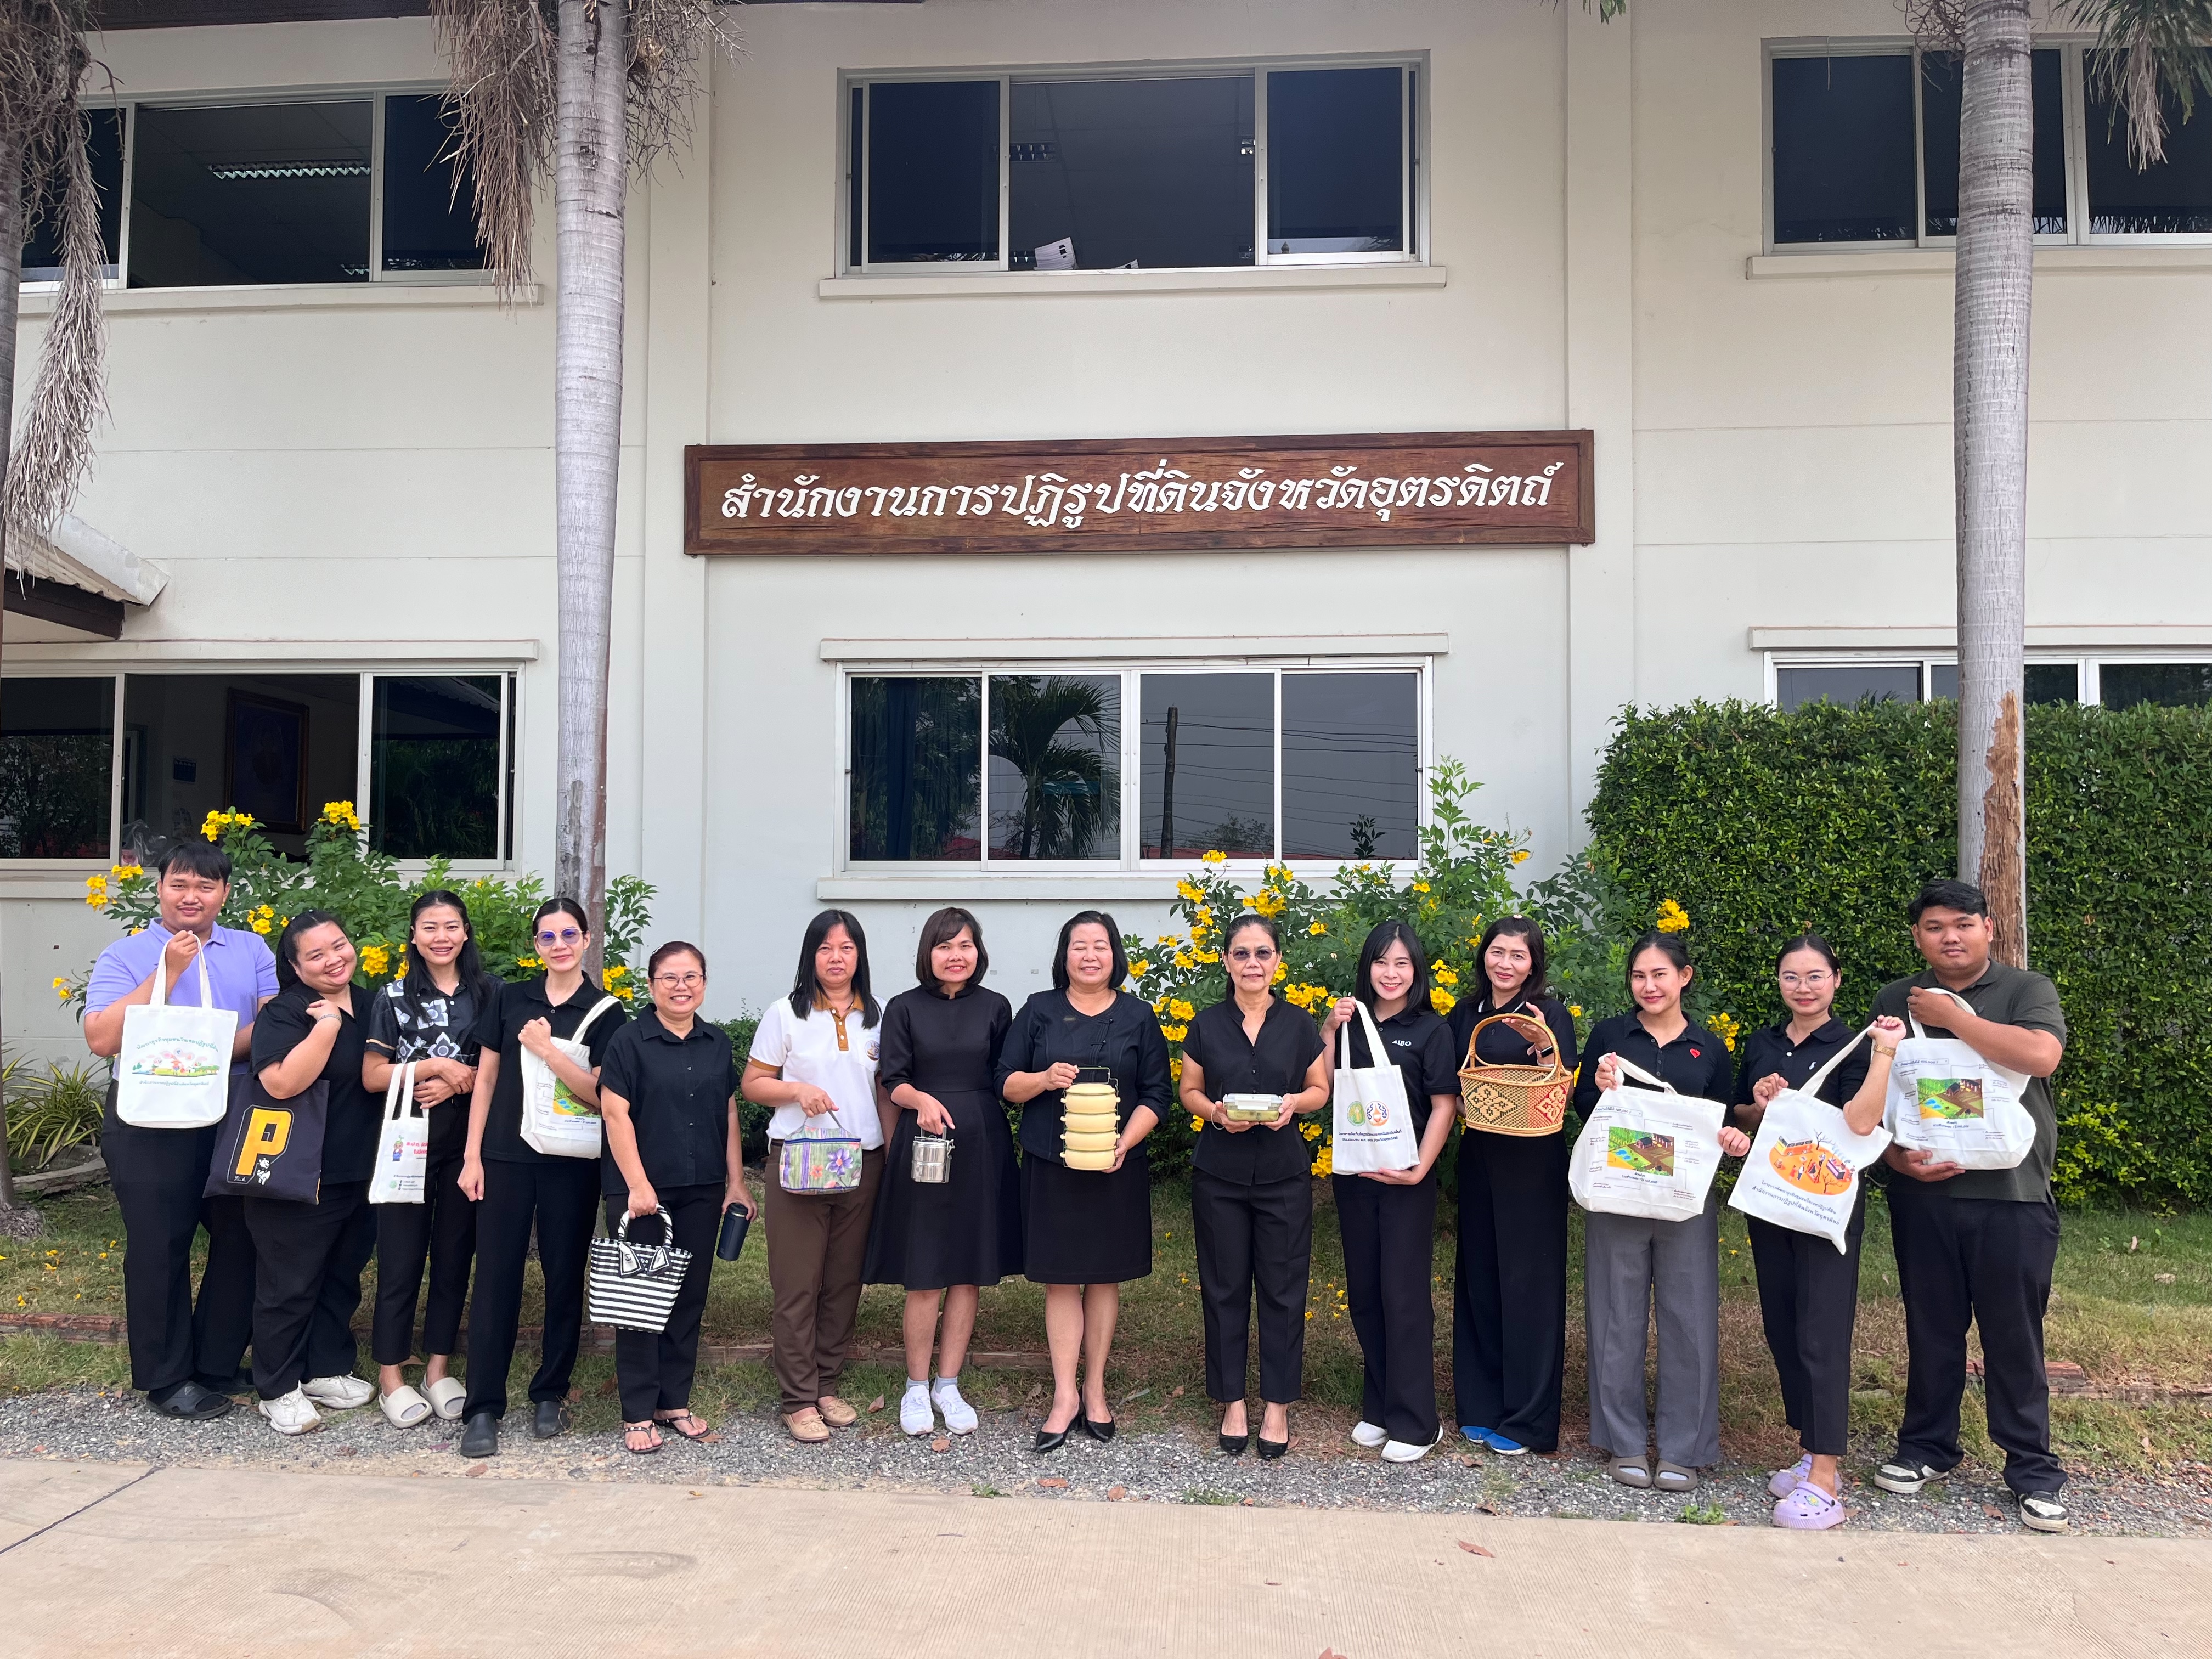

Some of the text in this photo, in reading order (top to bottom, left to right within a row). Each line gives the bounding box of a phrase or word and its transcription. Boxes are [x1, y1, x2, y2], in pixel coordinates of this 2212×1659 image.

[721, 459, 1562, 529] สำนักงานการปฏิรูปที่ดินจังหวัดอุตรดิตถ์
[235, 1107, 292, 1176] P
